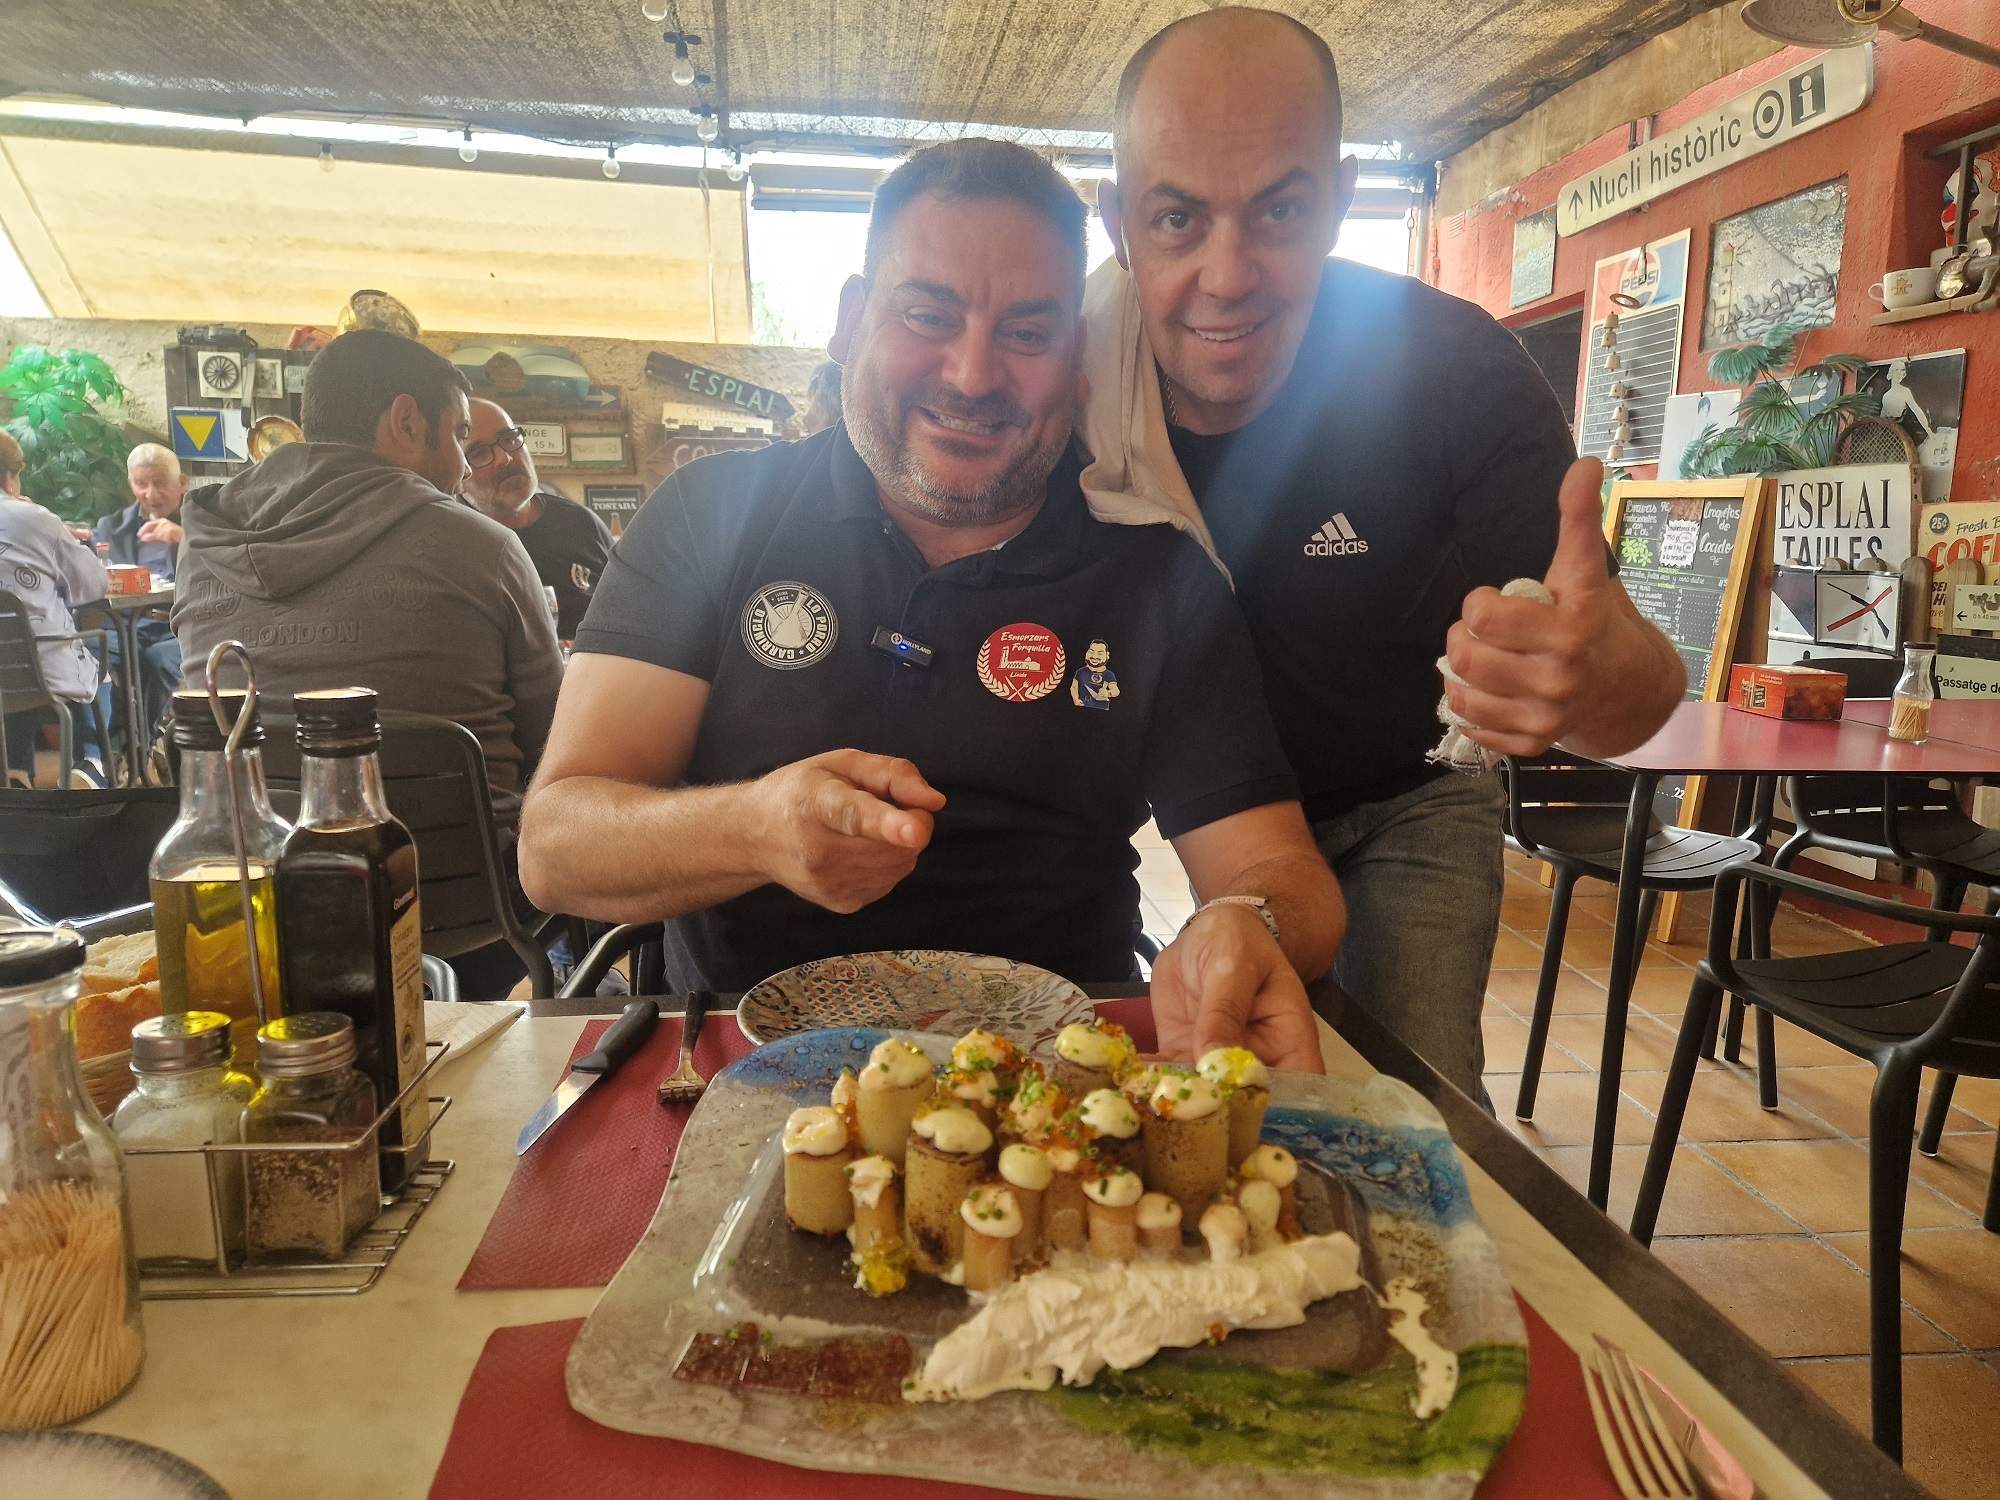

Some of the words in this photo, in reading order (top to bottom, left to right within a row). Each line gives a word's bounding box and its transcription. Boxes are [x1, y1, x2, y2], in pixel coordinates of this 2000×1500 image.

[1590, 155, 1641, 213] Nucli
[1650, 115, 1742, 183] històric
[1621, 269, 1659, 292] PESI
[688, 367, 774, 414] ESPLAI
[592, 502, 637, 510] TOSTADA
[1779, 479, 1891, 529] ESPLAI
[1956, 519, 1989, 535] Fresh
[1303, 539, 1369, 556] adidas
[806, 599, 822, 614] LO
[241, 622, 359, 648] LONDON
[805, 616, 828, 653] PORRO
[1001, 631, 1050, 642] Esmorzars
[1011, 643, 1051, 653] Forquilla
[1936, 675, 1987, 693] Passatge
[1674, 787, 1685, 800] 22
